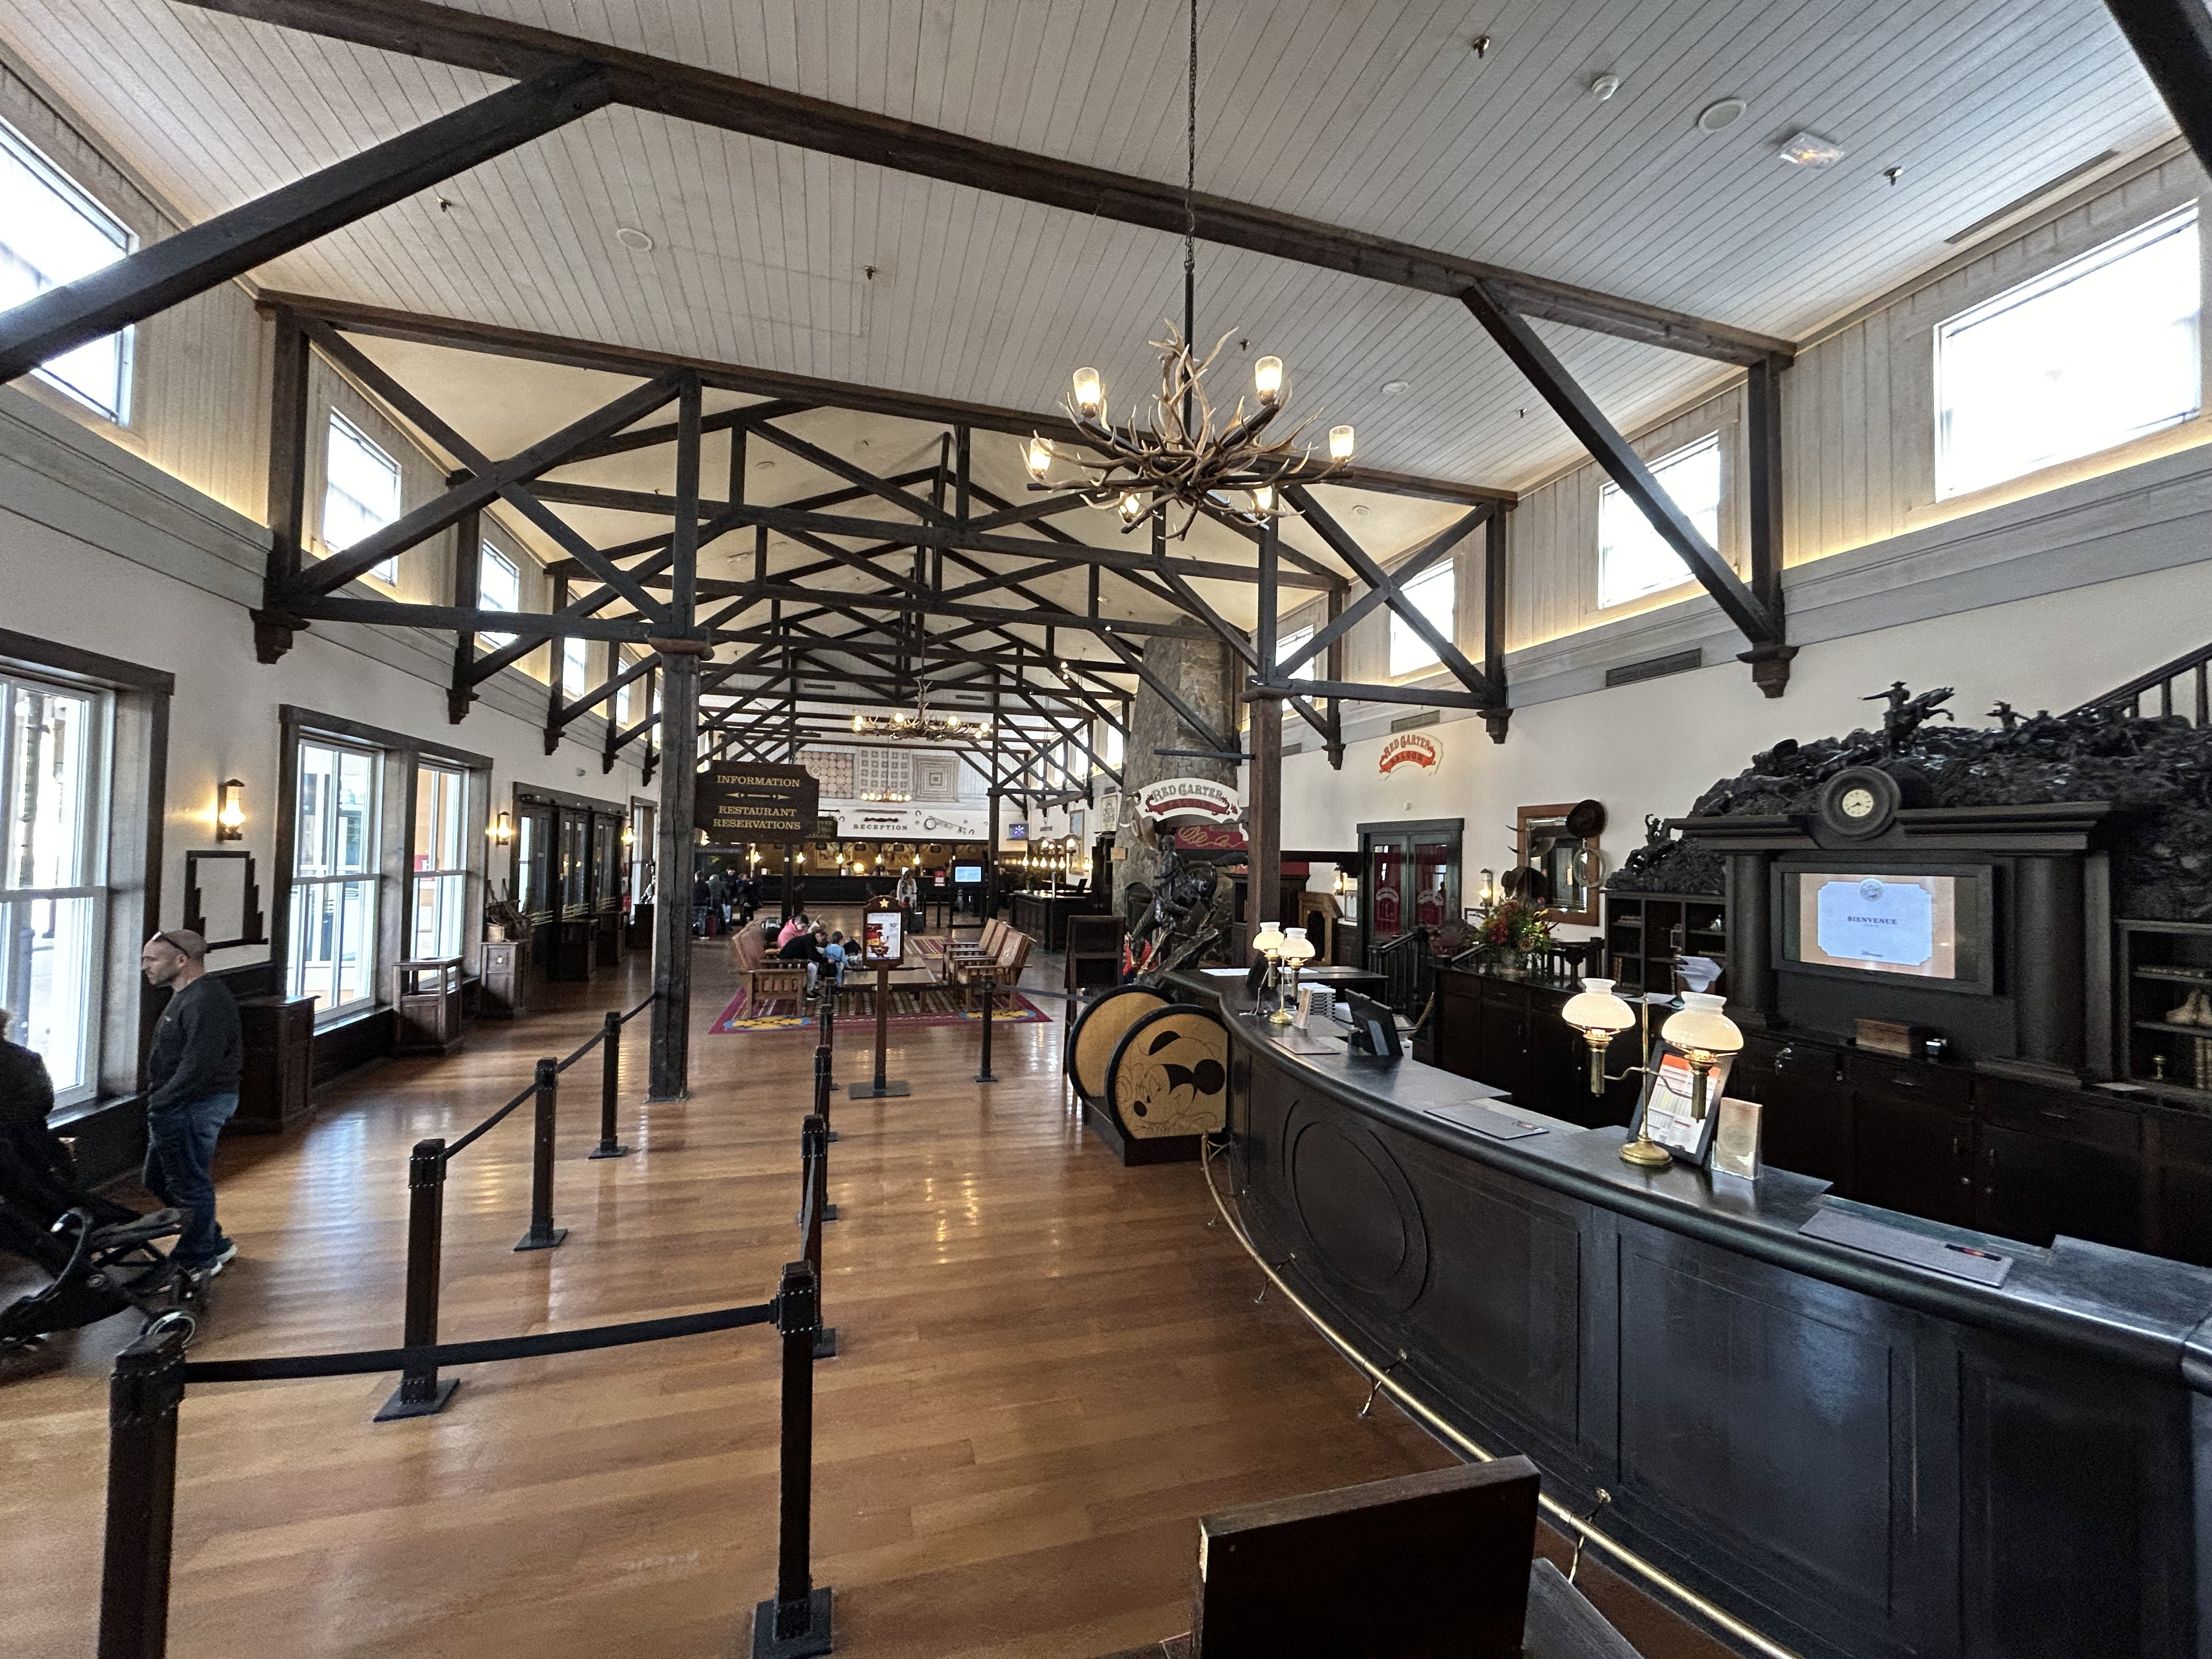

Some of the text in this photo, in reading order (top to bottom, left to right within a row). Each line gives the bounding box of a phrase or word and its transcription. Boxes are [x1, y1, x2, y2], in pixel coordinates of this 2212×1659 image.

[1384, 734, 1431, 757] RED GARTER
[716, 774, 800, 787] INFORMATION
[1153, 782, 1223, 803] RED GARTER
[718, 805, 797, 817] RESTAURANT
[713, 819, 801, 830] RESERVATIONS
[1847, 916, 1898, 925] BIENVENUE
